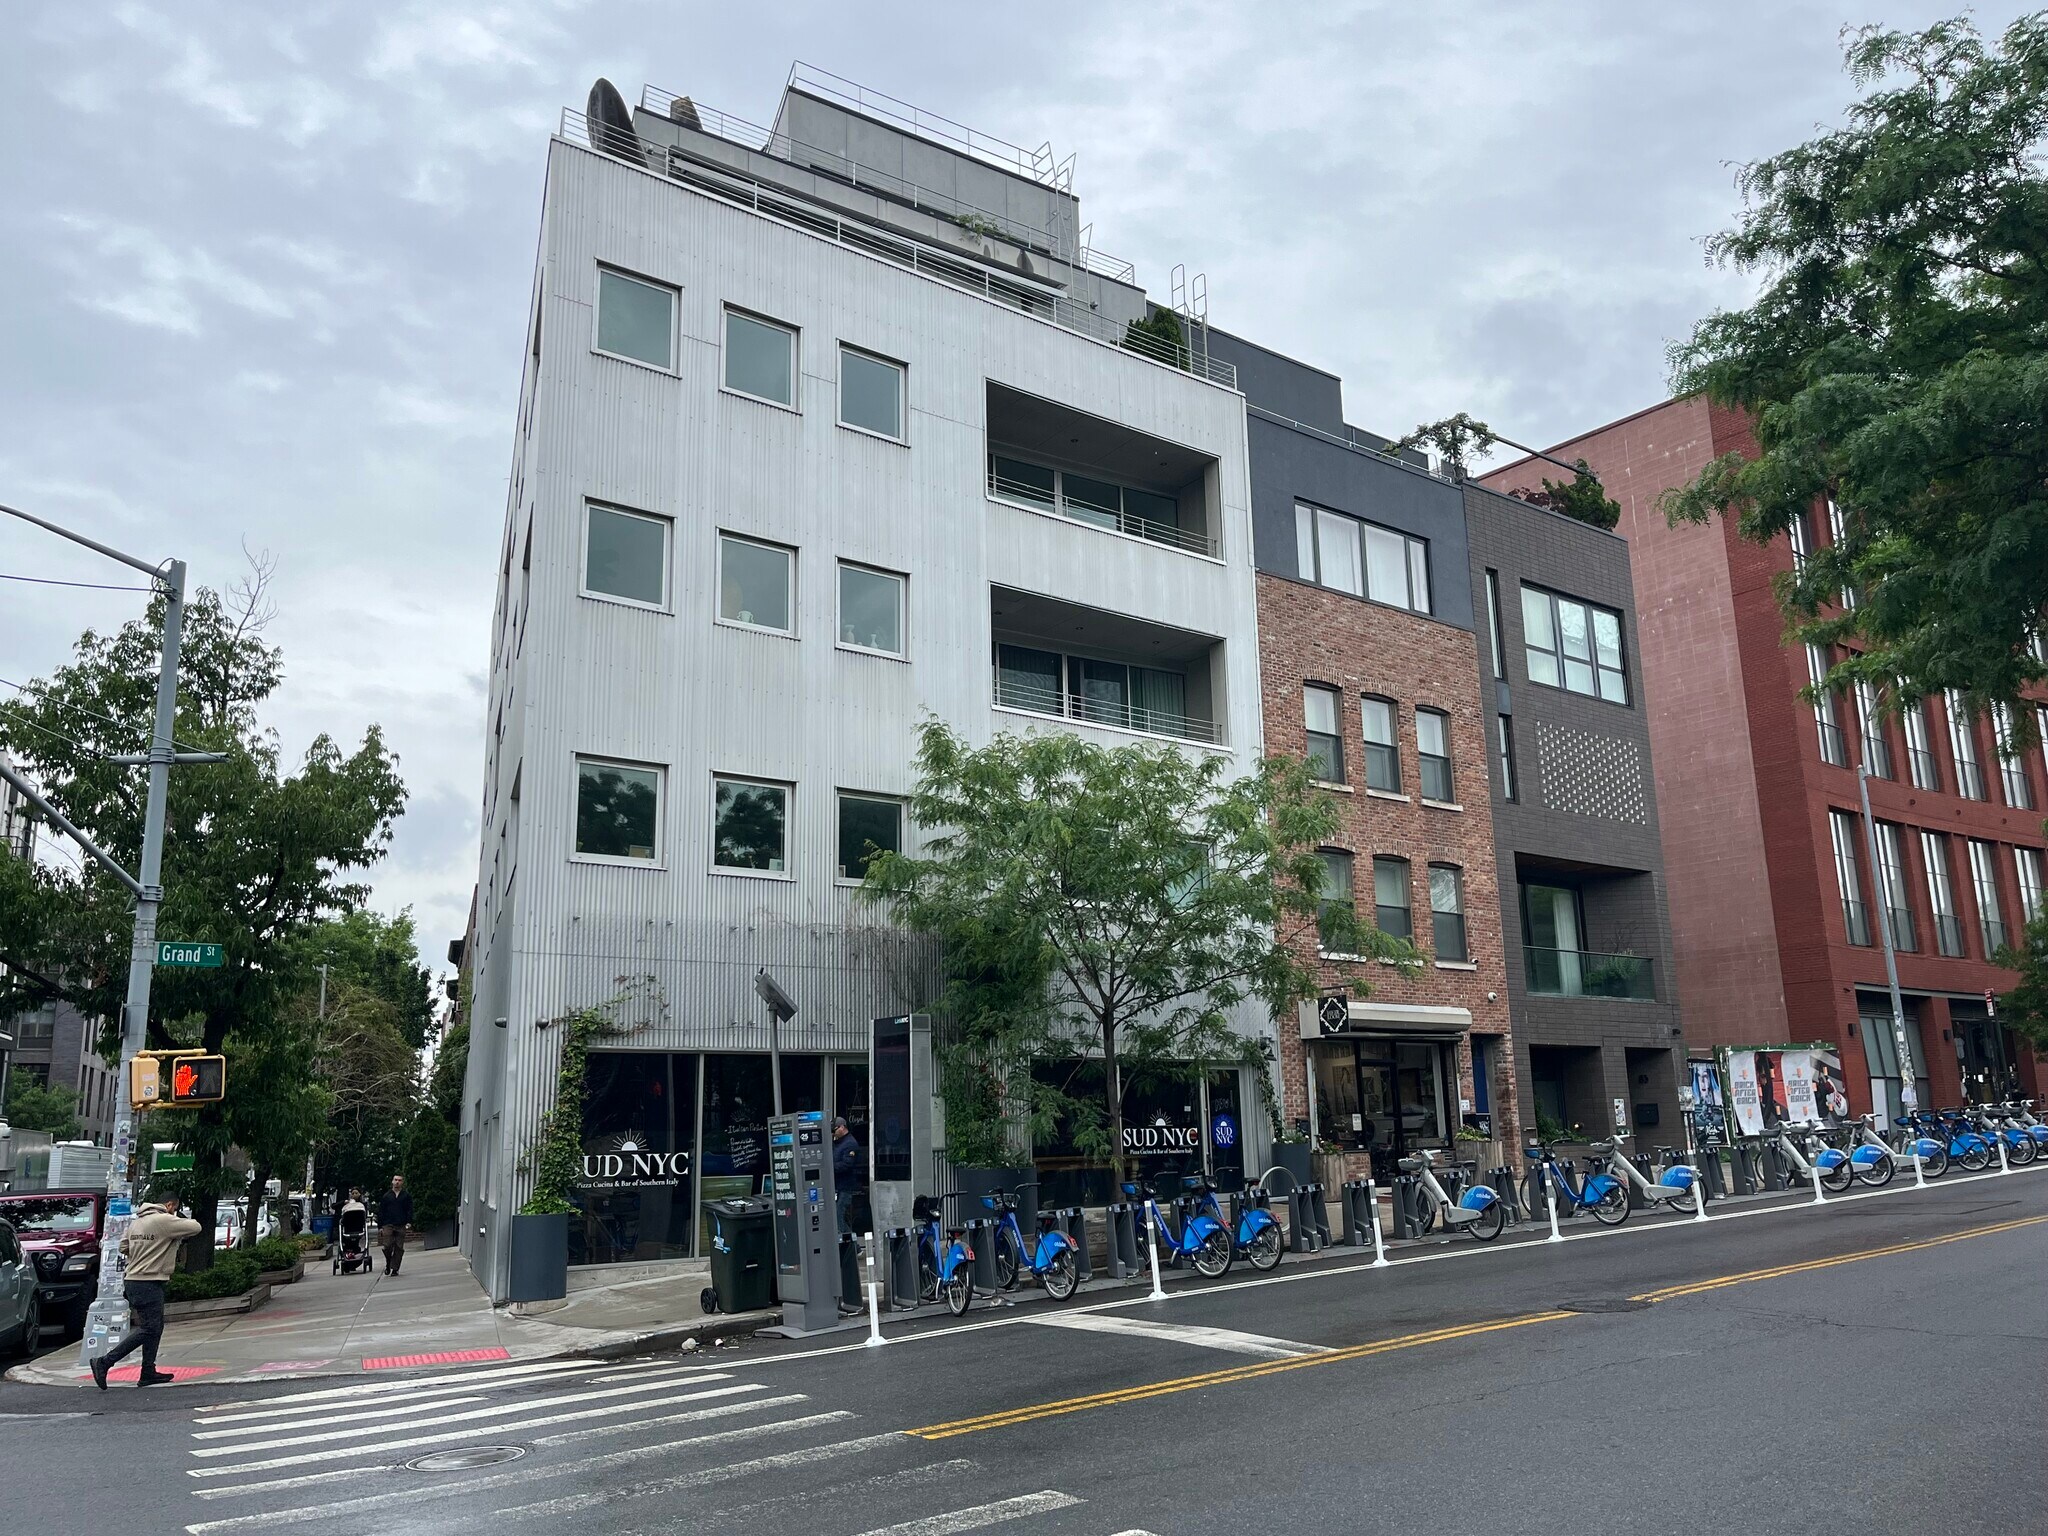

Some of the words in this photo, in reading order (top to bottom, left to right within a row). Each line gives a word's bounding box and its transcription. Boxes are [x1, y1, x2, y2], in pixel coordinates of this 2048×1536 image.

[162, 944, 201, 963] Grand
[206, 945, 216, 957] St
[1734, 1081, 1755, 1089] BRICK
[1788, 1079, 1809, 1087] BRICK
[1736, 1096, 1757, 1105] BRICK
[1791, 1094, 1811, 1103] BRICK
[1216, 1127, 1233, 1136] SUD
[1122, 1127, 1158, 1148] SUD
[1162, 1127, 1199, 1147] NYC
[1216, 1135, 1234, 1145] NYC
[573, 1154, 624, 1178] UD
[631, 1151, 689, 1177] NYC
[592, 1180, 613, 1188] Cucina
[639, 1178, 666, 1187] Southern
[666, 1177, 680, 1188] Italy
